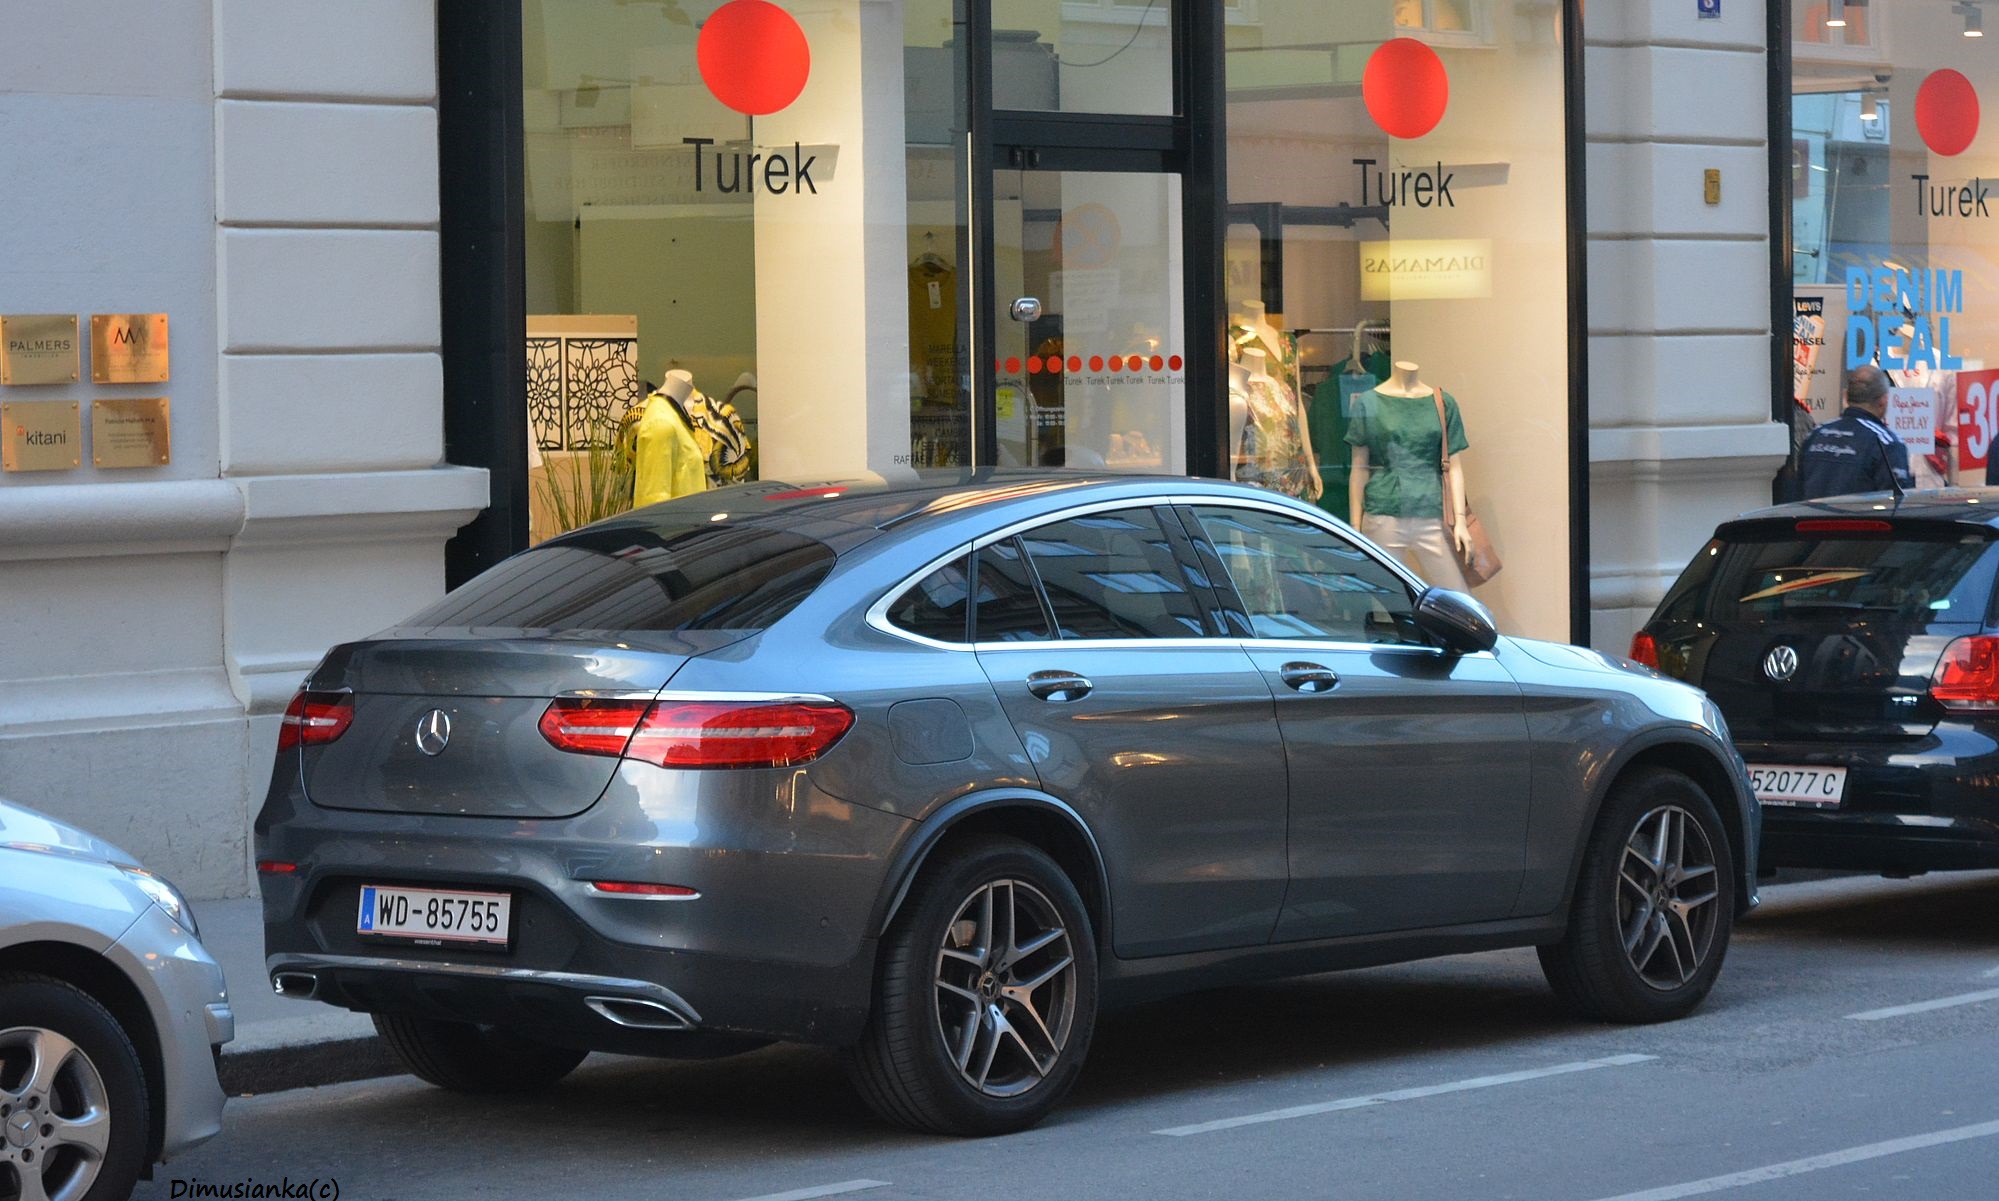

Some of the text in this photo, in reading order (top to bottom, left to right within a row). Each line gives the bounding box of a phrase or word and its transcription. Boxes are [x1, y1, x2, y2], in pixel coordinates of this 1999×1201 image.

[683, 138, 817, 194] Turek
[1353, 159, 1454, 207] Turek
[1911, 174, 1989, 217] Turek
[1845, 265, 1963, 313] DENIM
[10, 340, 71, 351] PALMERS
[1845, 315, 1963, 370] DEAL
[1064, 377, 1083, 385] Turek
[1087, 377, 1105, 385] Turek
[1106, 376, 1125, 385] Turek
[1126, 376, 1144, 384] Turek
[1148, 376, 1166, 384] Turek
[1167, 376, 1185, 384] Turek
[1895, 416, 1929, 430] REPLAY
[26, 430, 66, 446] kitani
[1752, 770, 1837, 795] 52077 C
[363, 914, 371, 925] A
[380, 895, 500, 932] WD-85755
